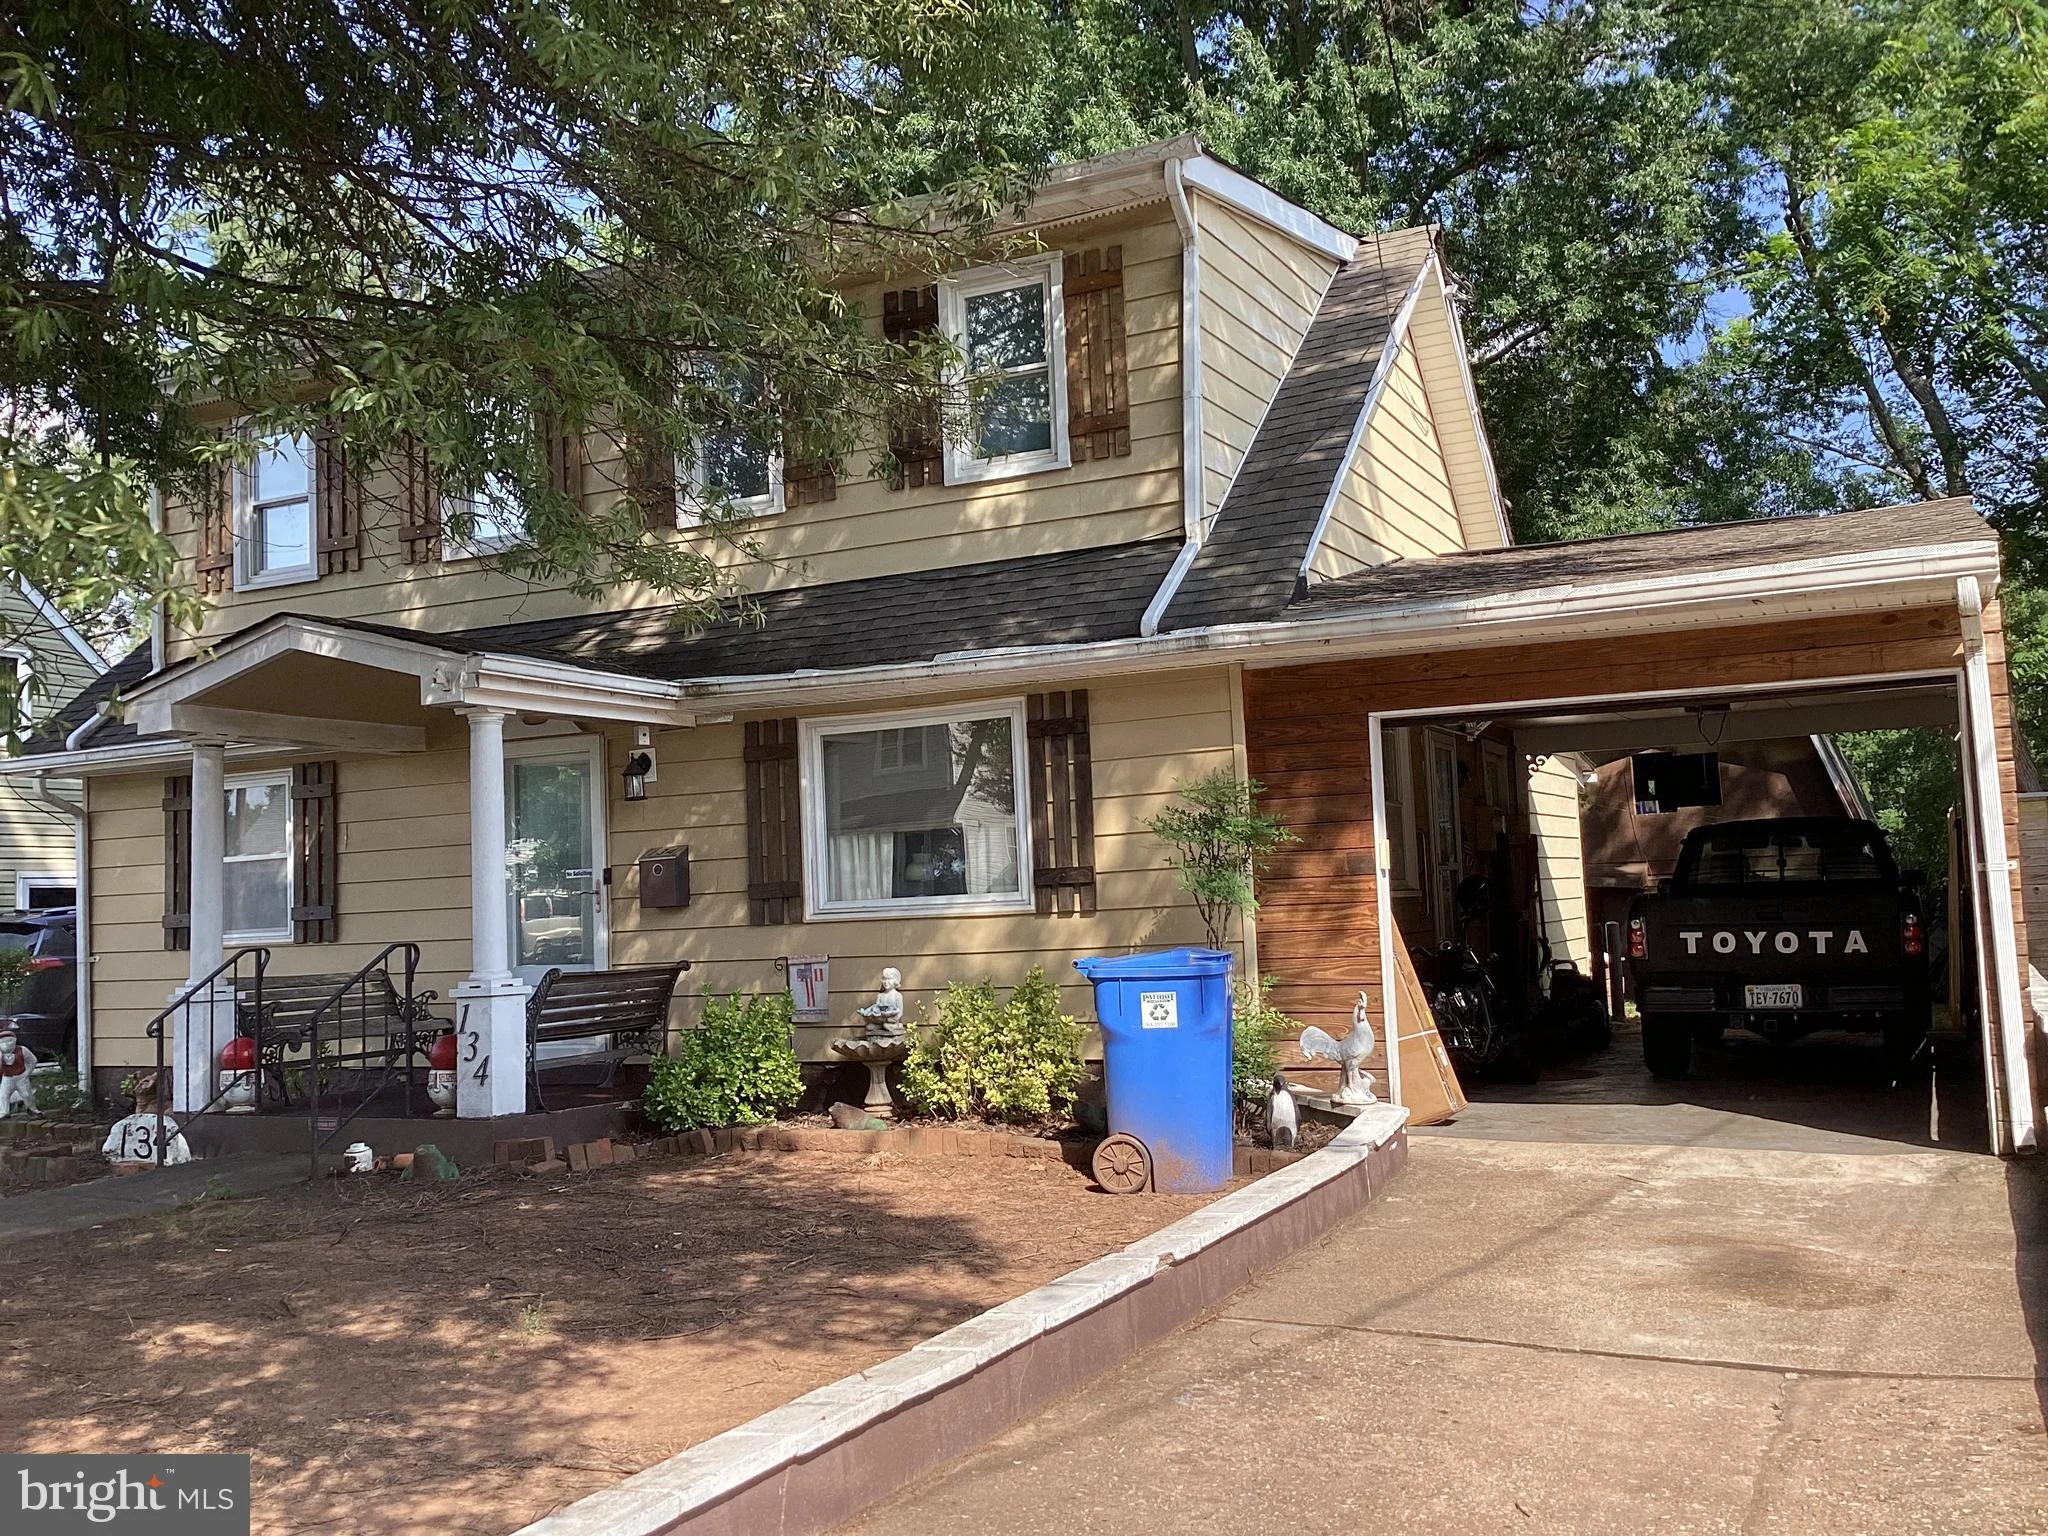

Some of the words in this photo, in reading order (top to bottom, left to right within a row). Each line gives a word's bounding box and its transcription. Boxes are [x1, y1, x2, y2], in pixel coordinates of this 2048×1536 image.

[1679, 930, 1869, 954] TOYOTA
[1142, 993, 1175, 1002] PATRIOT
[458, 1003, 491, 1088] 134
